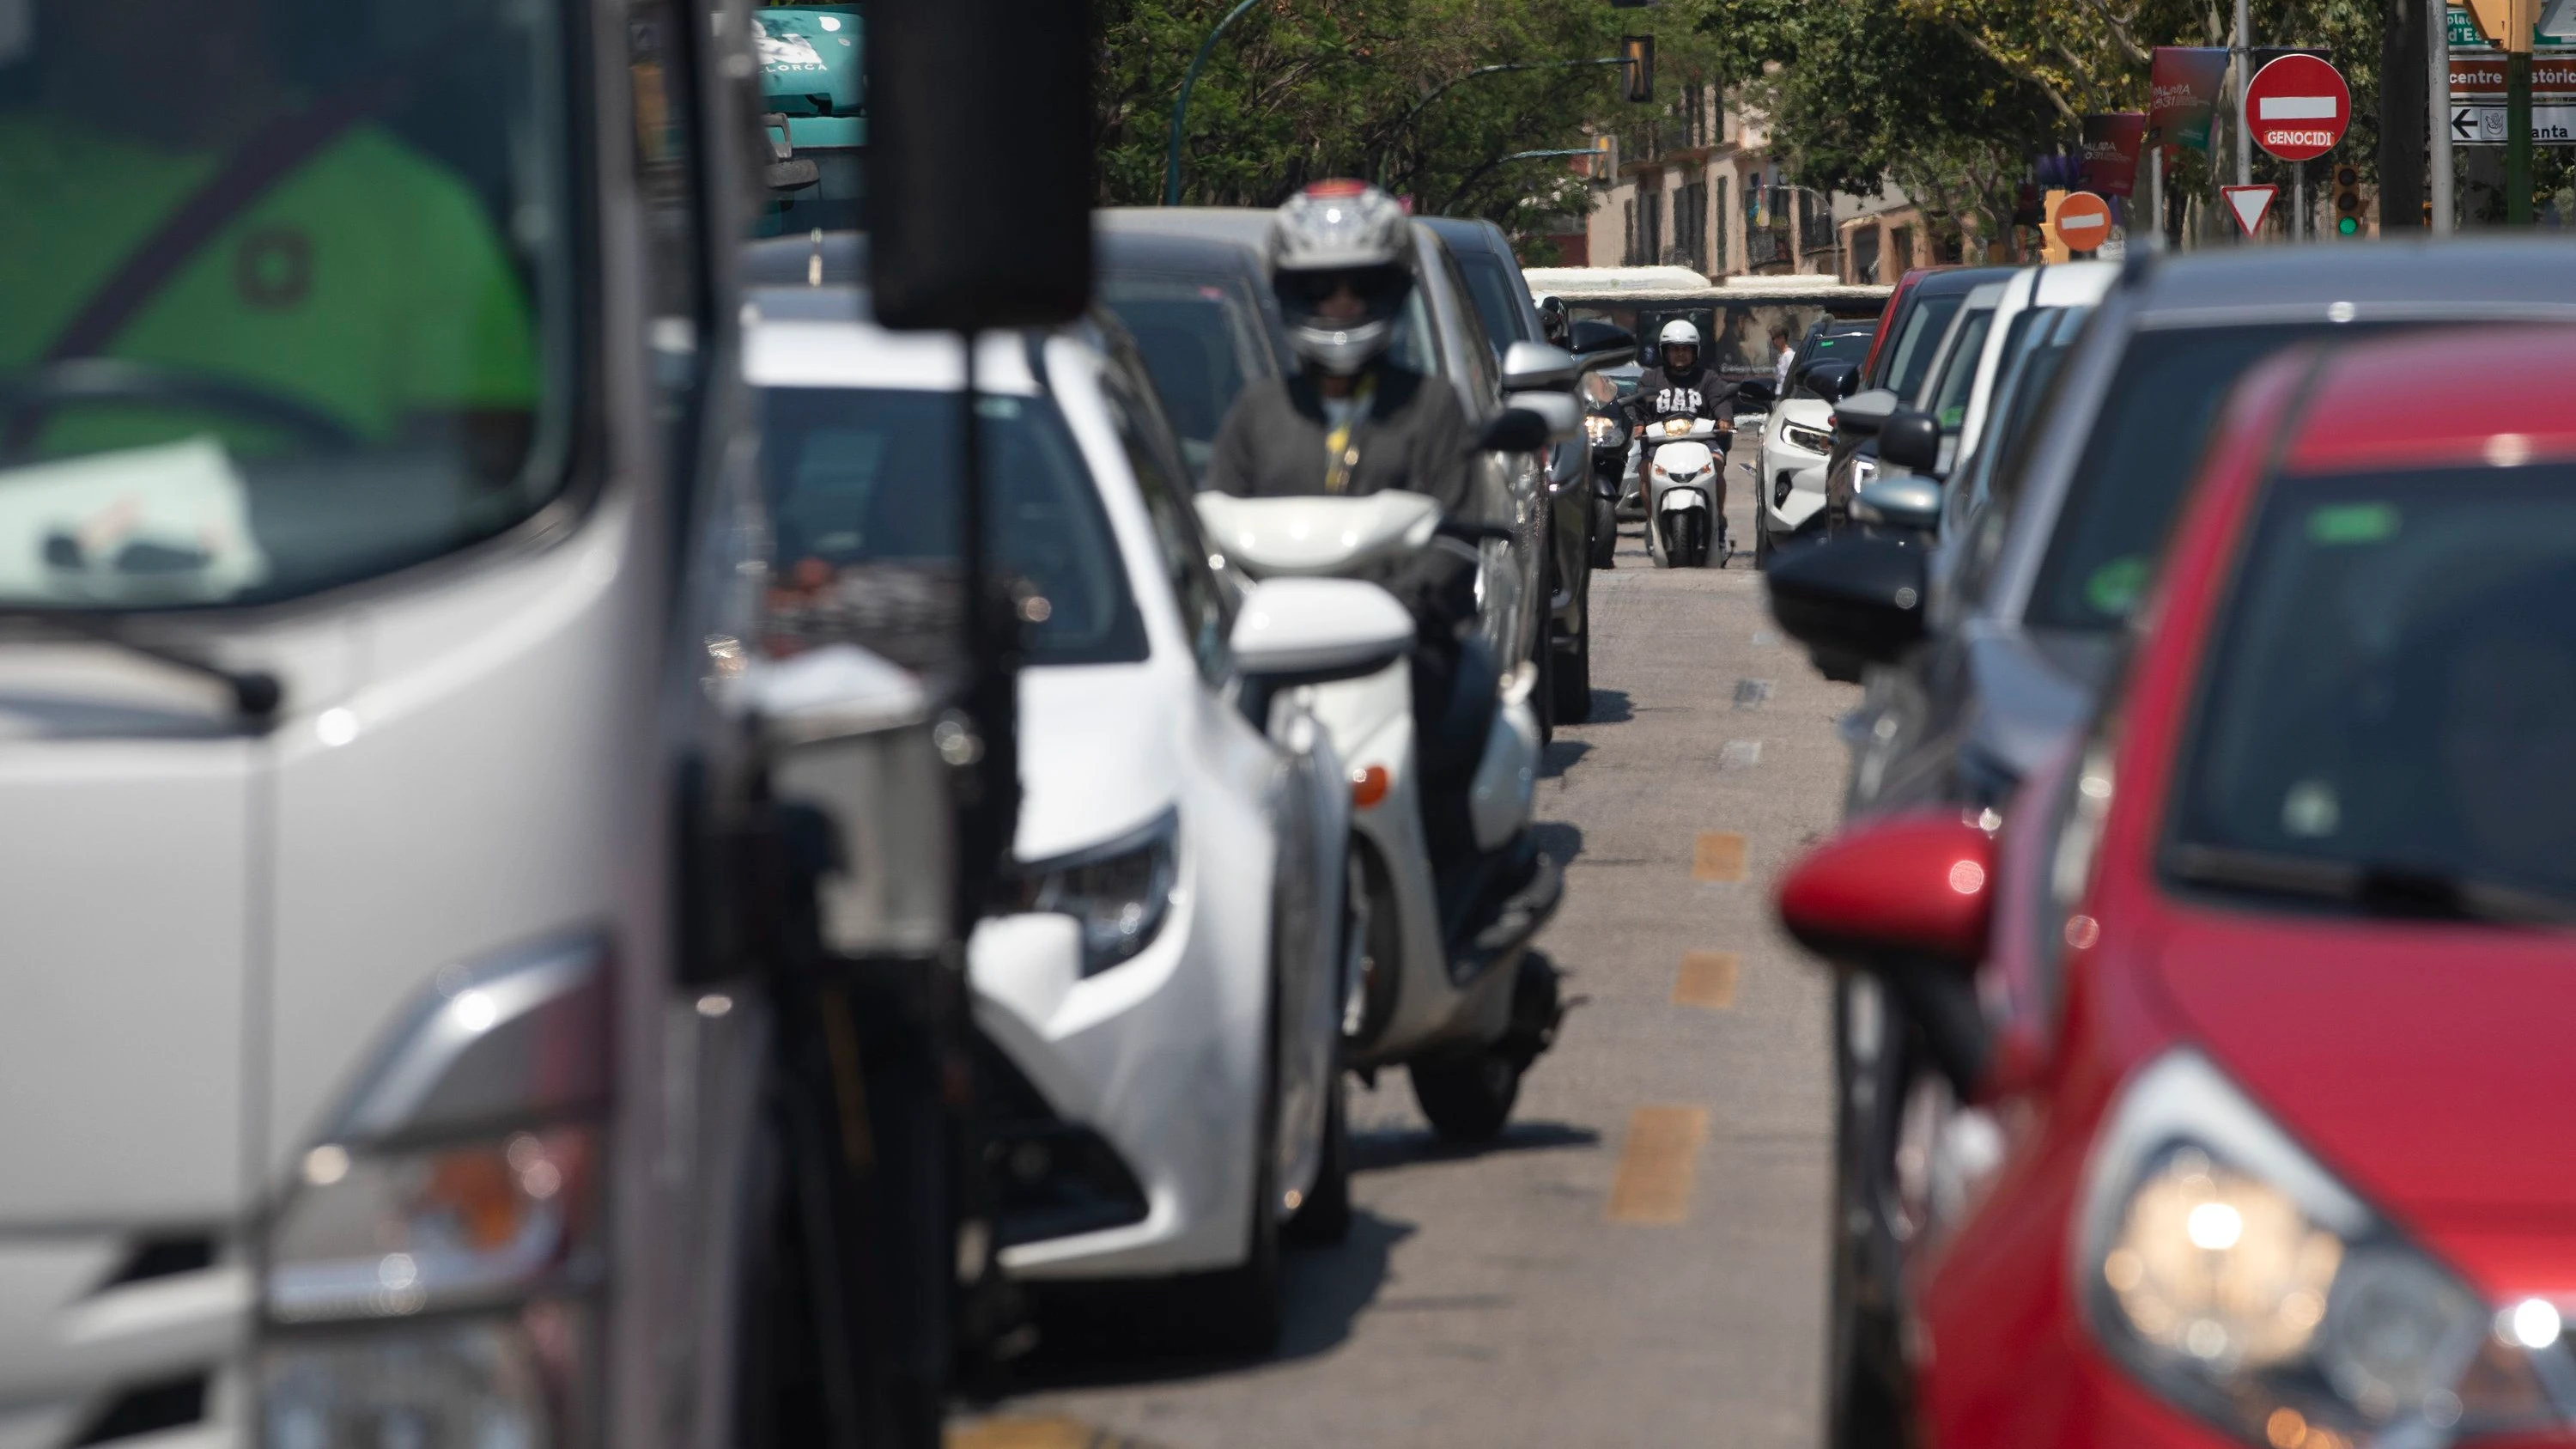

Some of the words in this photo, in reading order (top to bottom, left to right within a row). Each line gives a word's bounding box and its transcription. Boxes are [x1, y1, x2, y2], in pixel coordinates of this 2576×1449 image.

[2447, 14, 2472, 26] plaç
[2448, 27, 2483, 41] d'Es
[763, 64, 828, 73] LORCA
[2449, 70, 2502, 84] centre
[2532, 69, 2576, 84] stòric
[2268, 131, 2331, 146] GENOCIDI
[2532, 125, 2568, 138] anta
[1656, 387, 1703, 414] GAP
